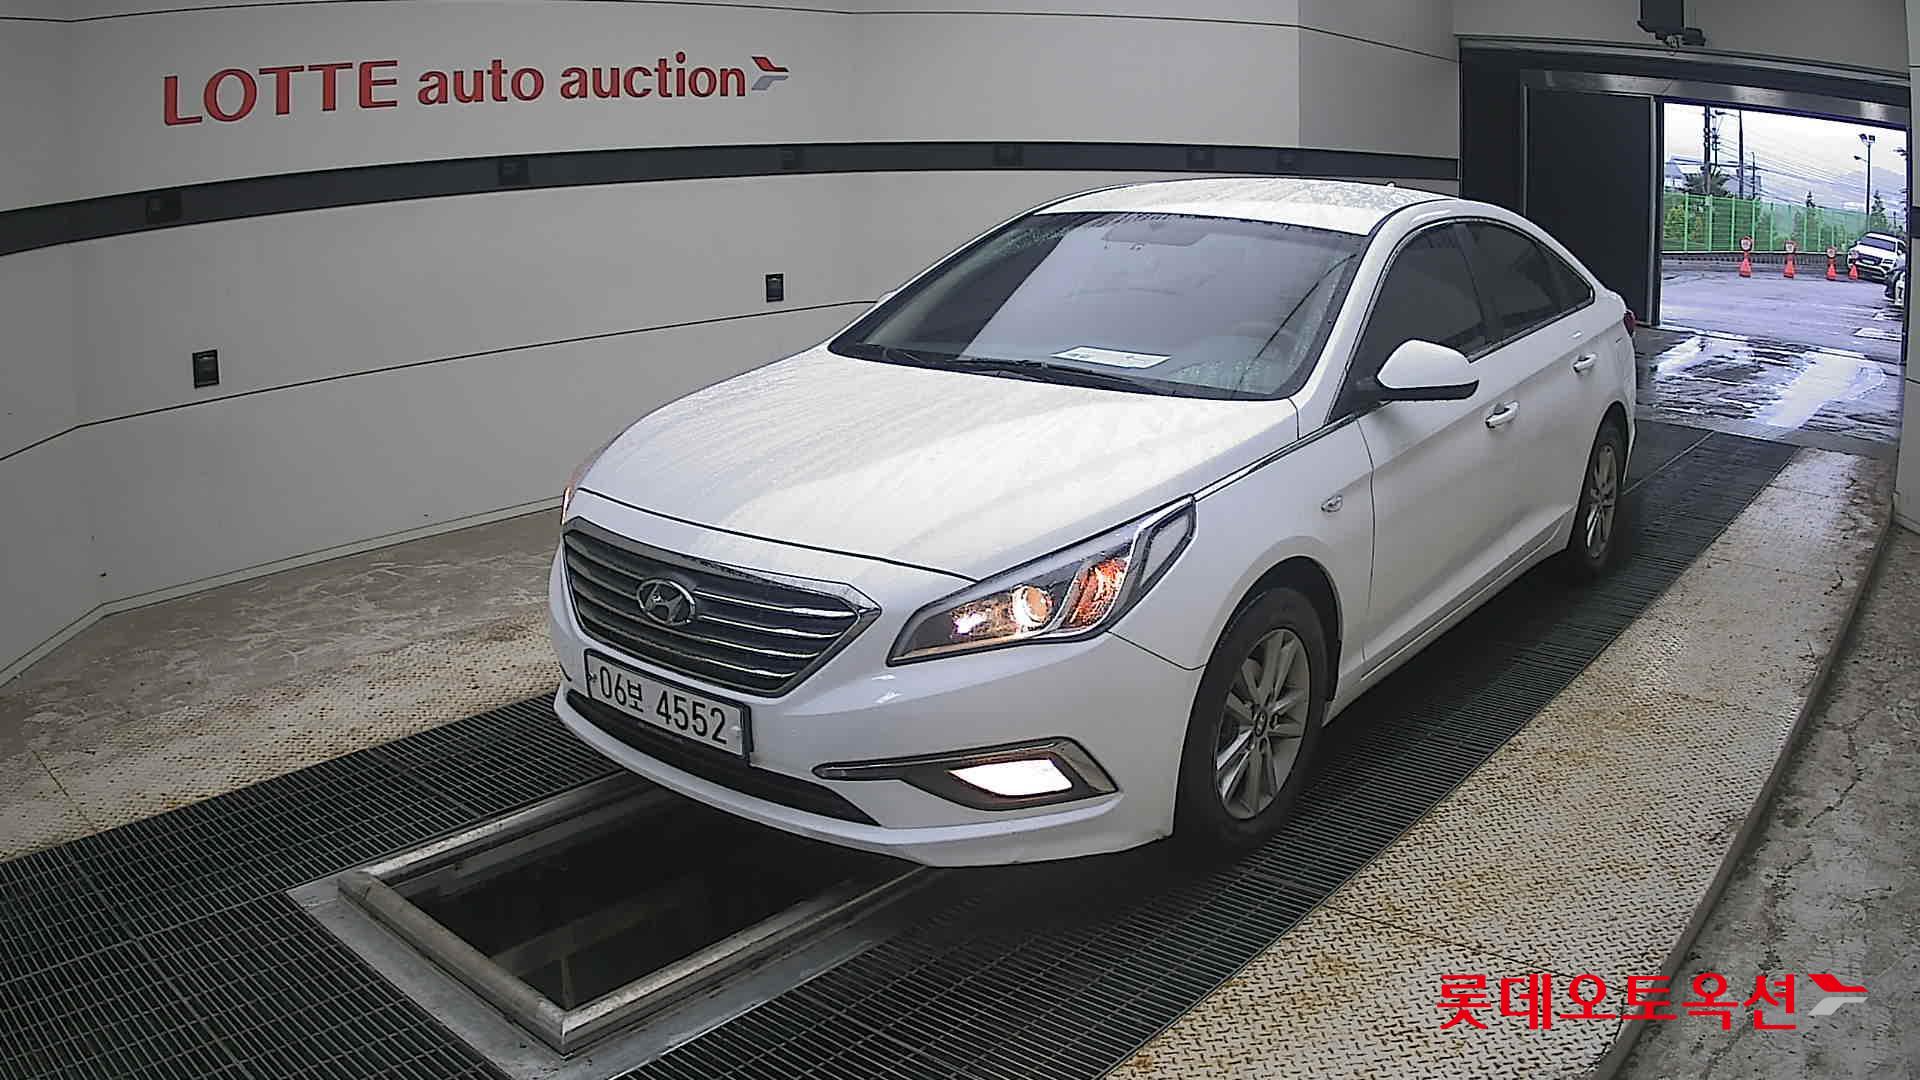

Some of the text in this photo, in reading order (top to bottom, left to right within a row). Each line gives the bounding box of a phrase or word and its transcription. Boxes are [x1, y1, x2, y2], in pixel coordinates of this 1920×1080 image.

[164, 51, 747, 126] LOTTE auto auction
[599, 666, 728, 745] 06보 4552
